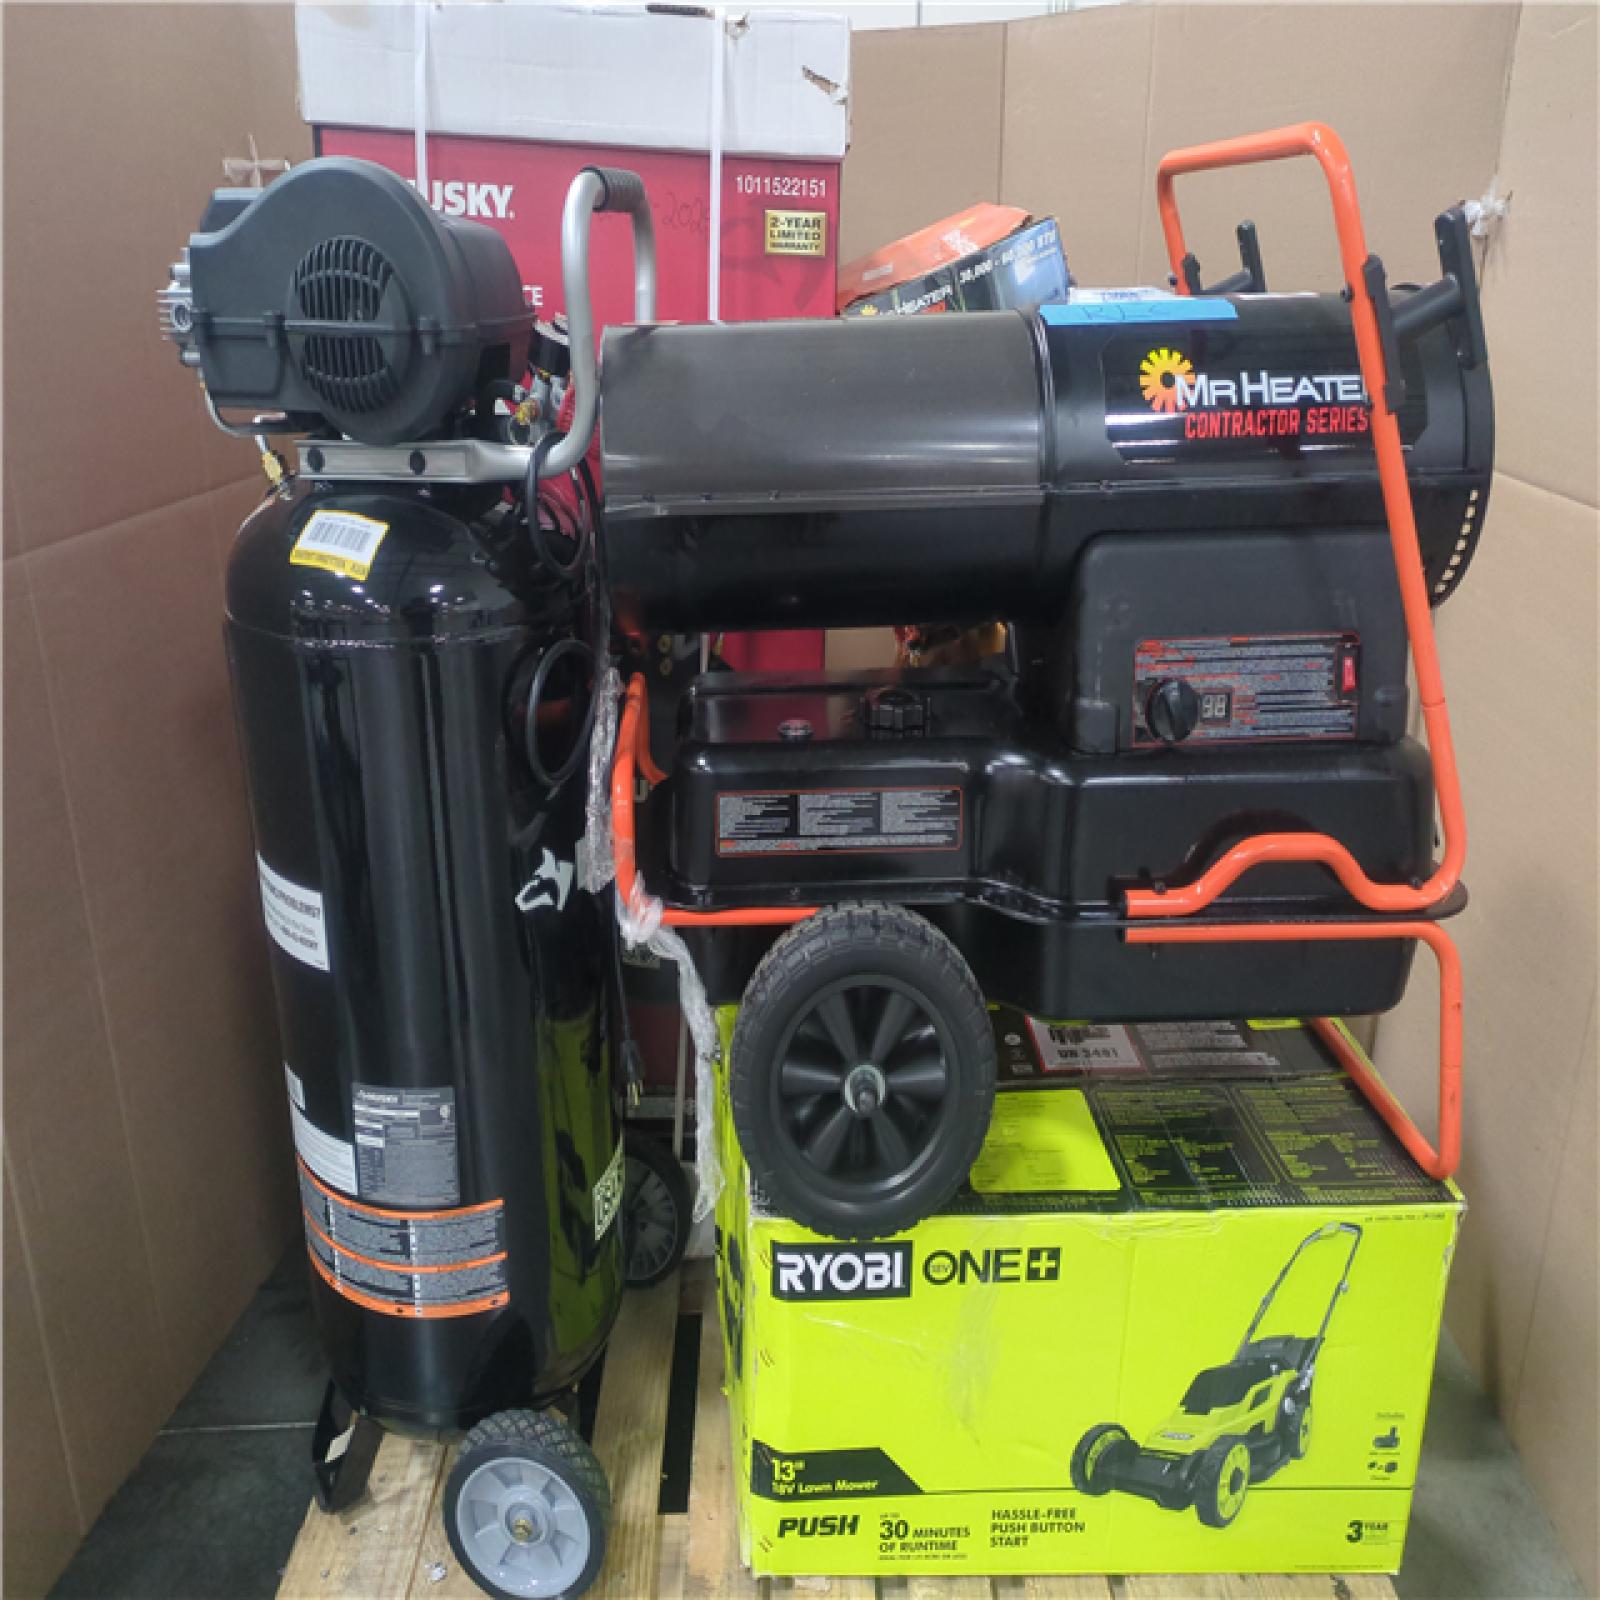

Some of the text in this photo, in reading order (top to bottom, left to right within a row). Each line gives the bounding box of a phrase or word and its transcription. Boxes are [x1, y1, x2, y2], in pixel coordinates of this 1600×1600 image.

[735, 174, 827, 198] 1011522151
[769, 216, 821, 229] 2-YEAR
[769, 230, 821, 241] LIMITED
[1239, 370, 1369, 405] HEATE
[1185, 406, 1369, 439] CONTRACTOR SERIES
[776, 1249, 906, 1294] RYOBI
[991, 1507, 1077, 1521] HASSLE-FREE
[777, 1514, 860, 1538] PUSH
[879, 1519, 971, 1541] 30 MINUTES
[990, 1521, 1086, 1534] PUSH BUTTON
[1346, 1520, 1363, 1543] 3
[879, 1539, 958, 1553] OF RUNTIME
[989, 1534, 1029, 1548] START
